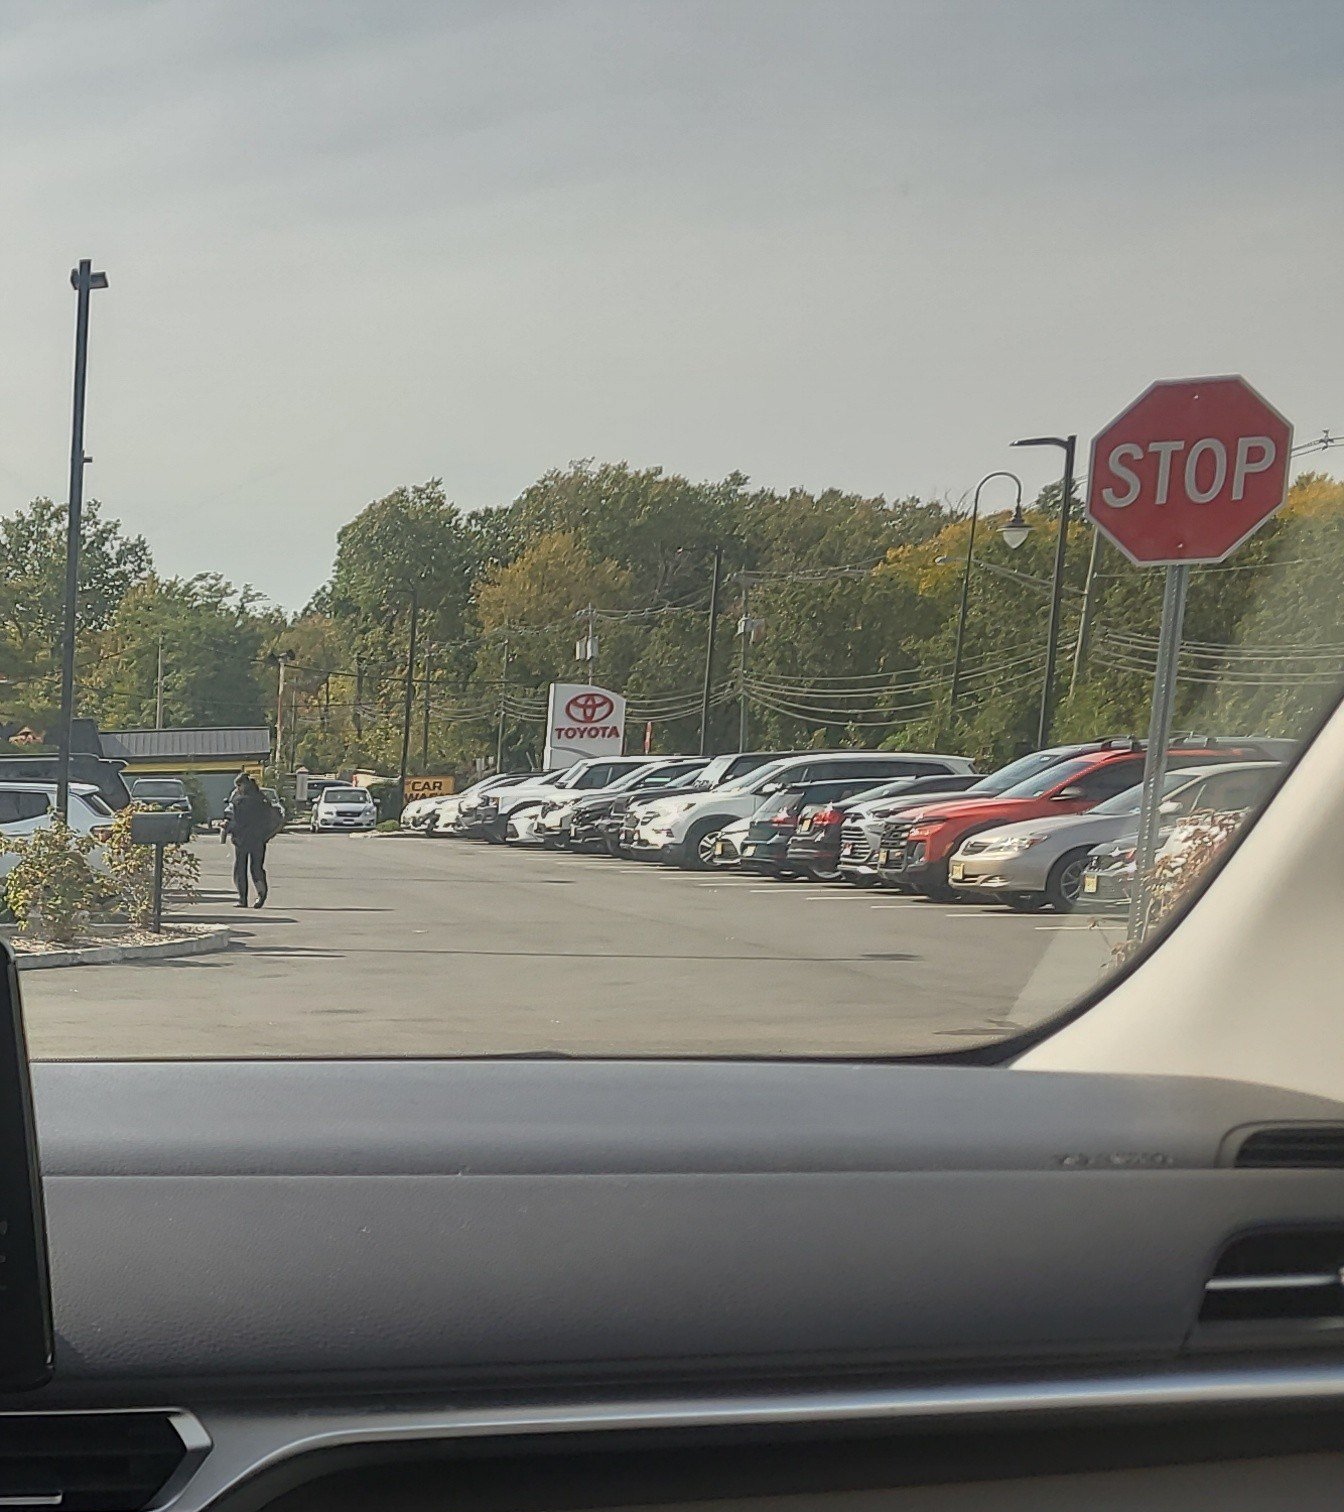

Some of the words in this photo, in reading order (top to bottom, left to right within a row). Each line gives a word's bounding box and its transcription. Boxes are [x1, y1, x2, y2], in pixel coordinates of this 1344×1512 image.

[1102, 436, 1276, 508] STOP
[555, 726, 620, 739] TOYOTA
[412, 781, 442, 791] CAR
